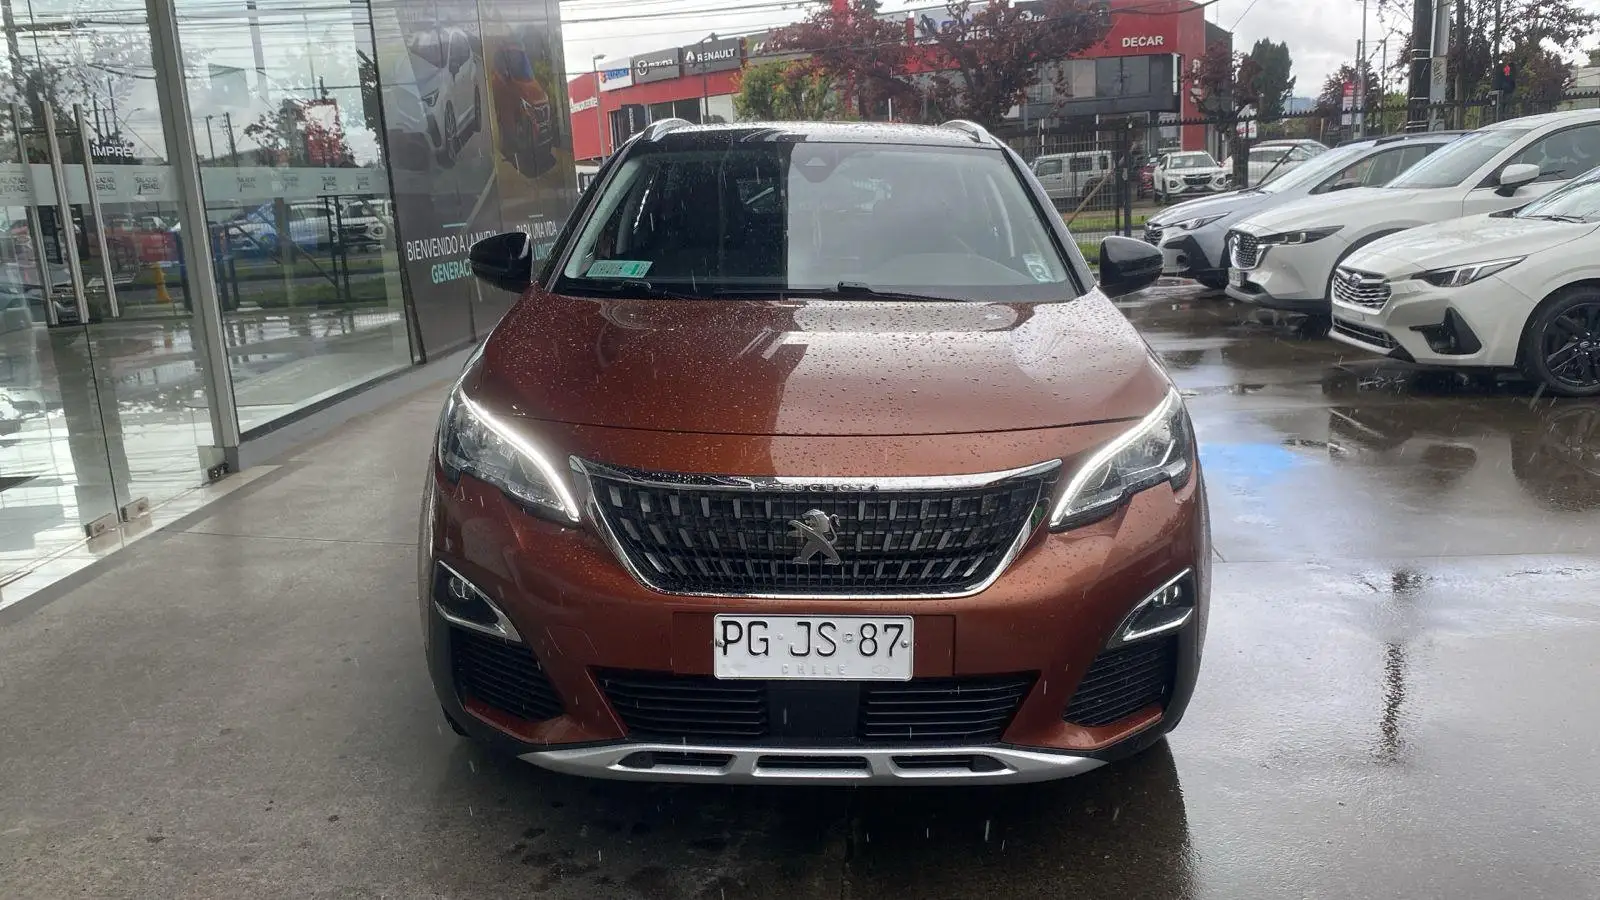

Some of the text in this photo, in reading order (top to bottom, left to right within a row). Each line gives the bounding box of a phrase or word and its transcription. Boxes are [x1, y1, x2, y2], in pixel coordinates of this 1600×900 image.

[1122, 35, 1164, 48] DECAR
[697, 48, 735, 63] RENAULT
[407, 238, 458, 261] BIENVENIDO
[460, 239, 466, 252] A
[721, 620, 904, 657] PG JS 87
[781, 663, 847, 675] CHILE
